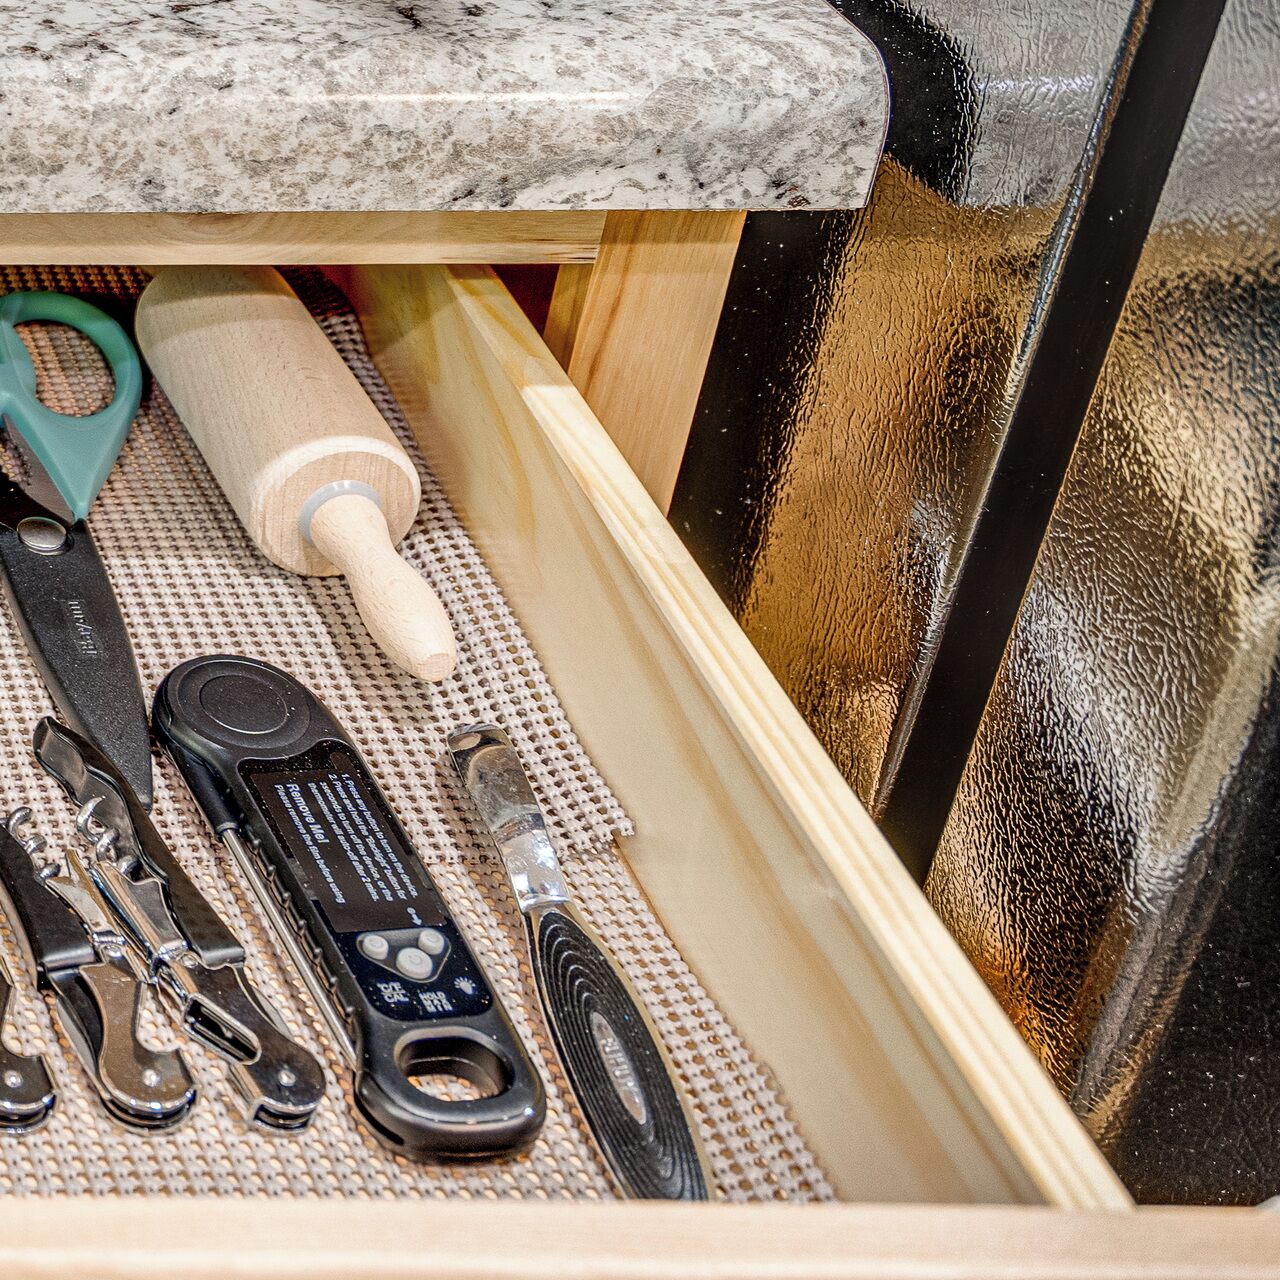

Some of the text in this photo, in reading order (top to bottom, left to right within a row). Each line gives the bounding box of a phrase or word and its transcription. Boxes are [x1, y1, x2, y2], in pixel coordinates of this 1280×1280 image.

[274, 785, 292, 807] Please
[288, 808, 306, 833] remove
[286, 784, 329, 843] Remove Me!
[332, 781, 347, 798] Press
[343, 798, 356, 811] and
[350, 811, 364, 825] hold
[384, 869, 401, 890] button
[396, 889, 407, 900] for
[345, 780, 360, 797] Press
[363, 811, 380, 831] button
[380, 839, 392, 852] turn
[388, 853, 398, 862] on
